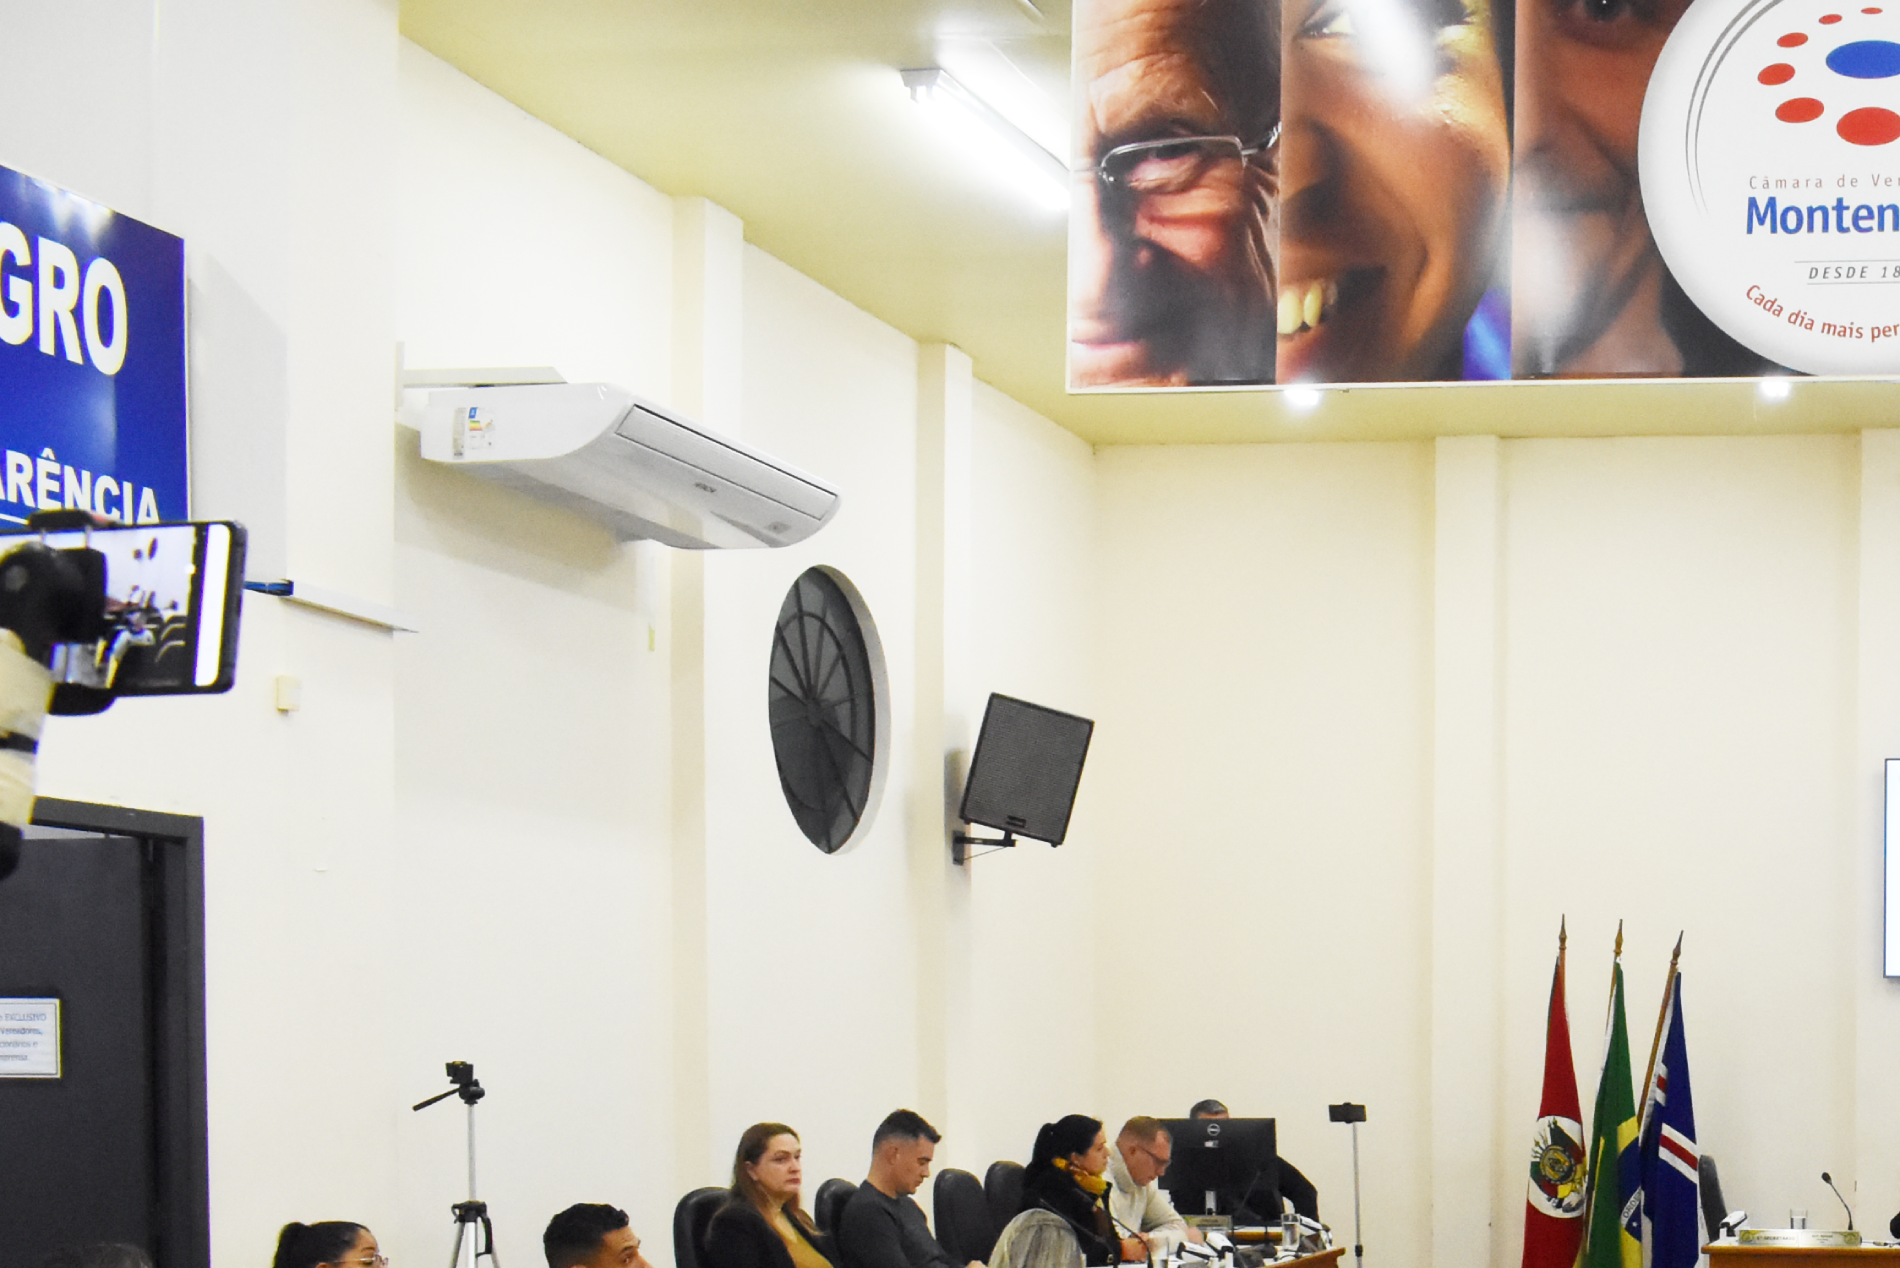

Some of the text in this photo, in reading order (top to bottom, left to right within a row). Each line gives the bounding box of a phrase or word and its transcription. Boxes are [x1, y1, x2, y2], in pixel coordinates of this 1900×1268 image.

[1749, 175, 1823, 190] Câmara
[1837, 174, 1858, 188] de
[0, 221, 128, 375] GRO
[1808, 266, 1869, 280] DESDE
[1746, 284, 1784, 318] Cada
[1787, 309, 1815, 331] dia
[1821, 321, 1864, 340] mais
[0, 447, 161, 526] RÊNCIA
